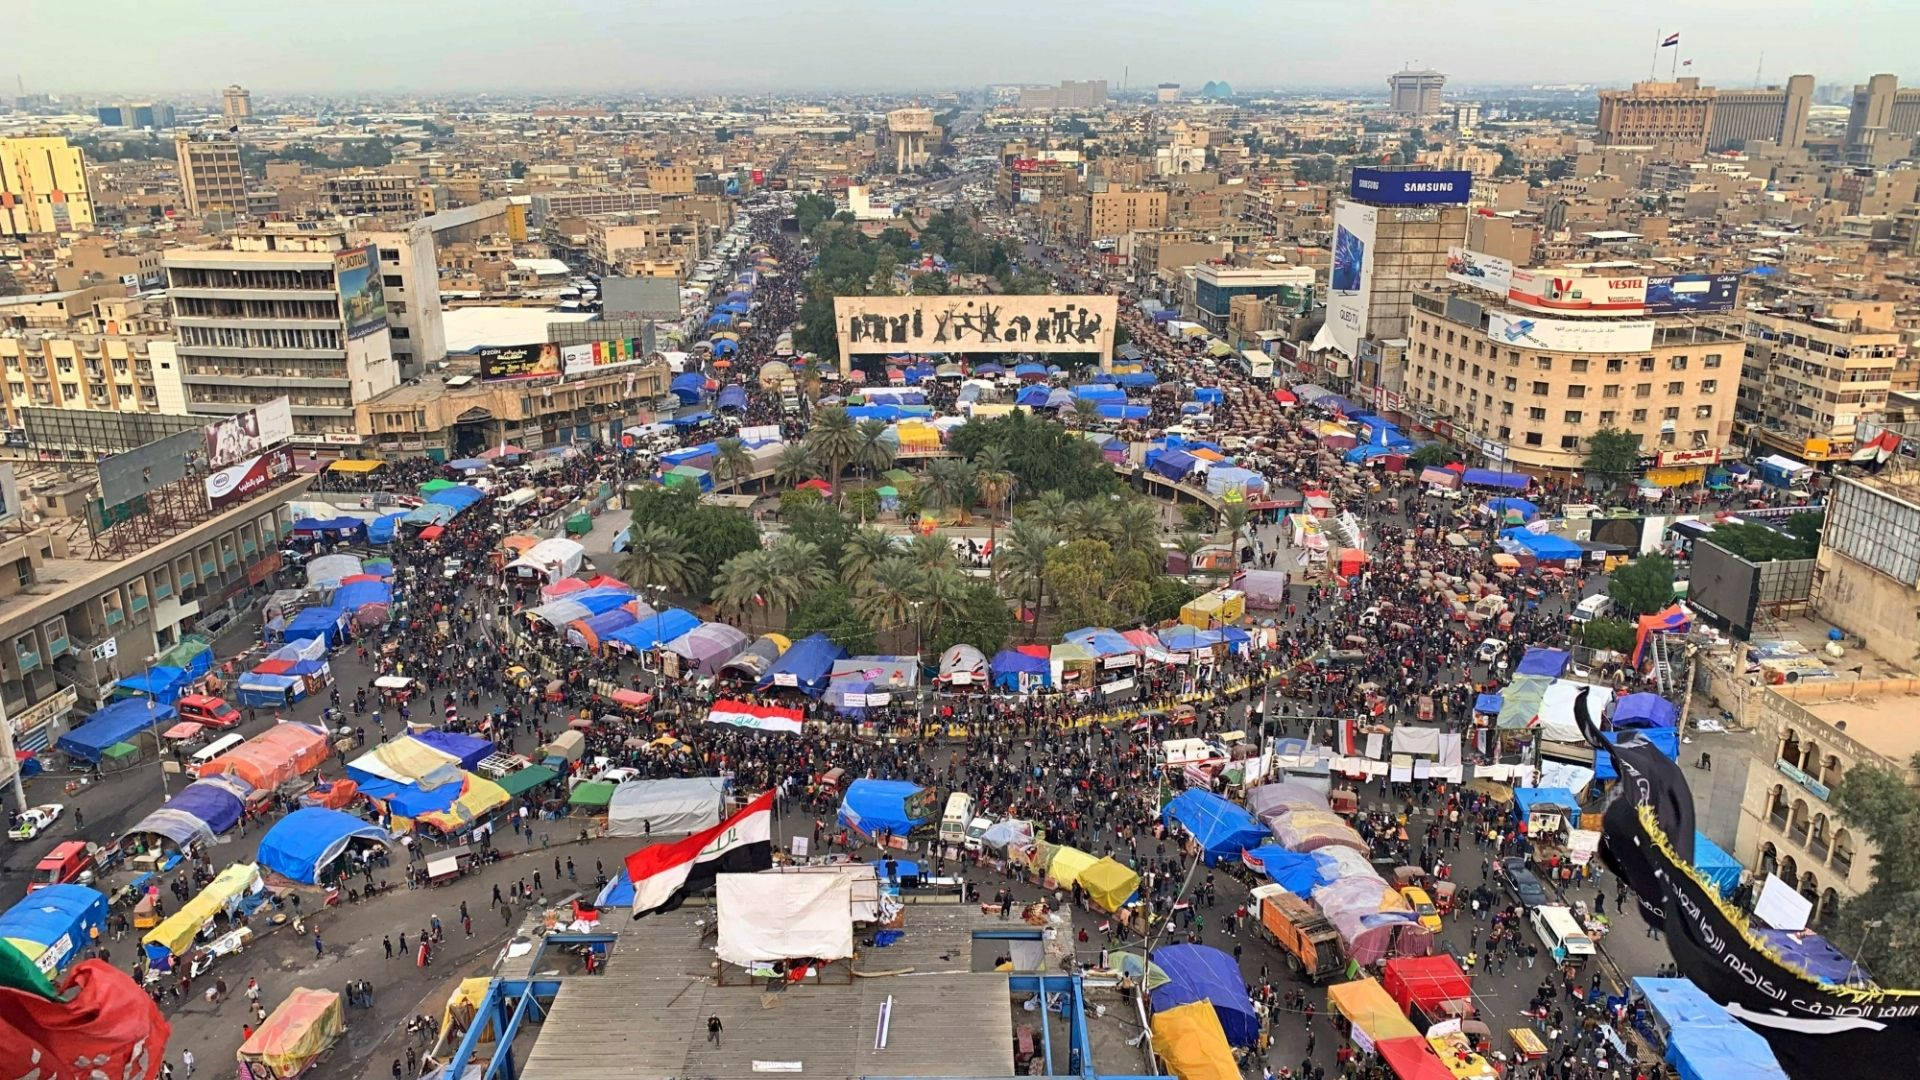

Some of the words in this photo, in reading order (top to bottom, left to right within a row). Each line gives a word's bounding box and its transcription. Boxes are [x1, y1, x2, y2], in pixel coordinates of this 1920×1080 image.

[1404, 182, 1453, 192] SAMSUNG
[345, 254, 367, 268] JOTUN
[1608, 280, 1643, 289] VESTEL
[1700, 916, 1725, 955] الرضا
[1723, 953, 1787, 1001] الكاظم
[1791, 999, 1874, 1018] الصادق
